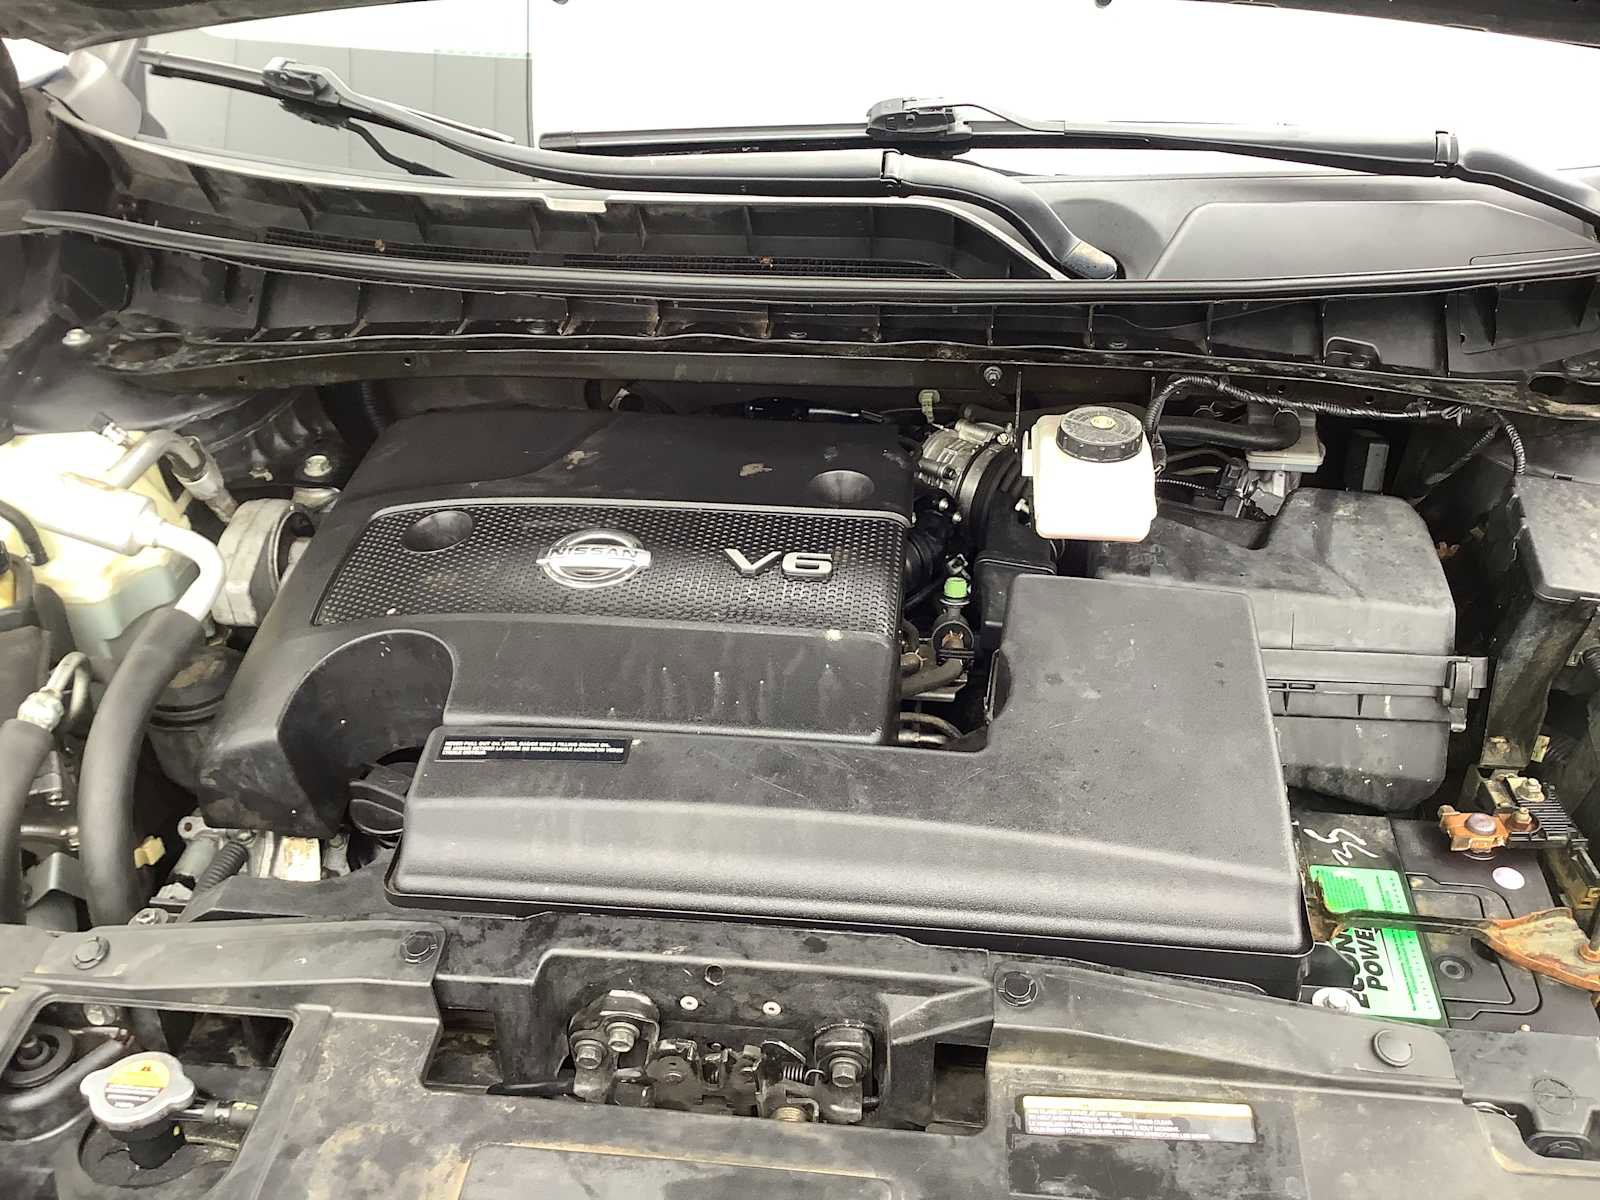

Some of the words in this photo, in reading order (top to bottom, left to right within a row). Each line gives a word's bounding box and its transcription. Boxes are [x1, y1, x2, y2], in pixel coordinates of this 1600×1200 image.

[549, 546, 639, 559] NISSAN
[723, 548, 833, 582] V6
[1354, 926, 1389, 992] POWE
